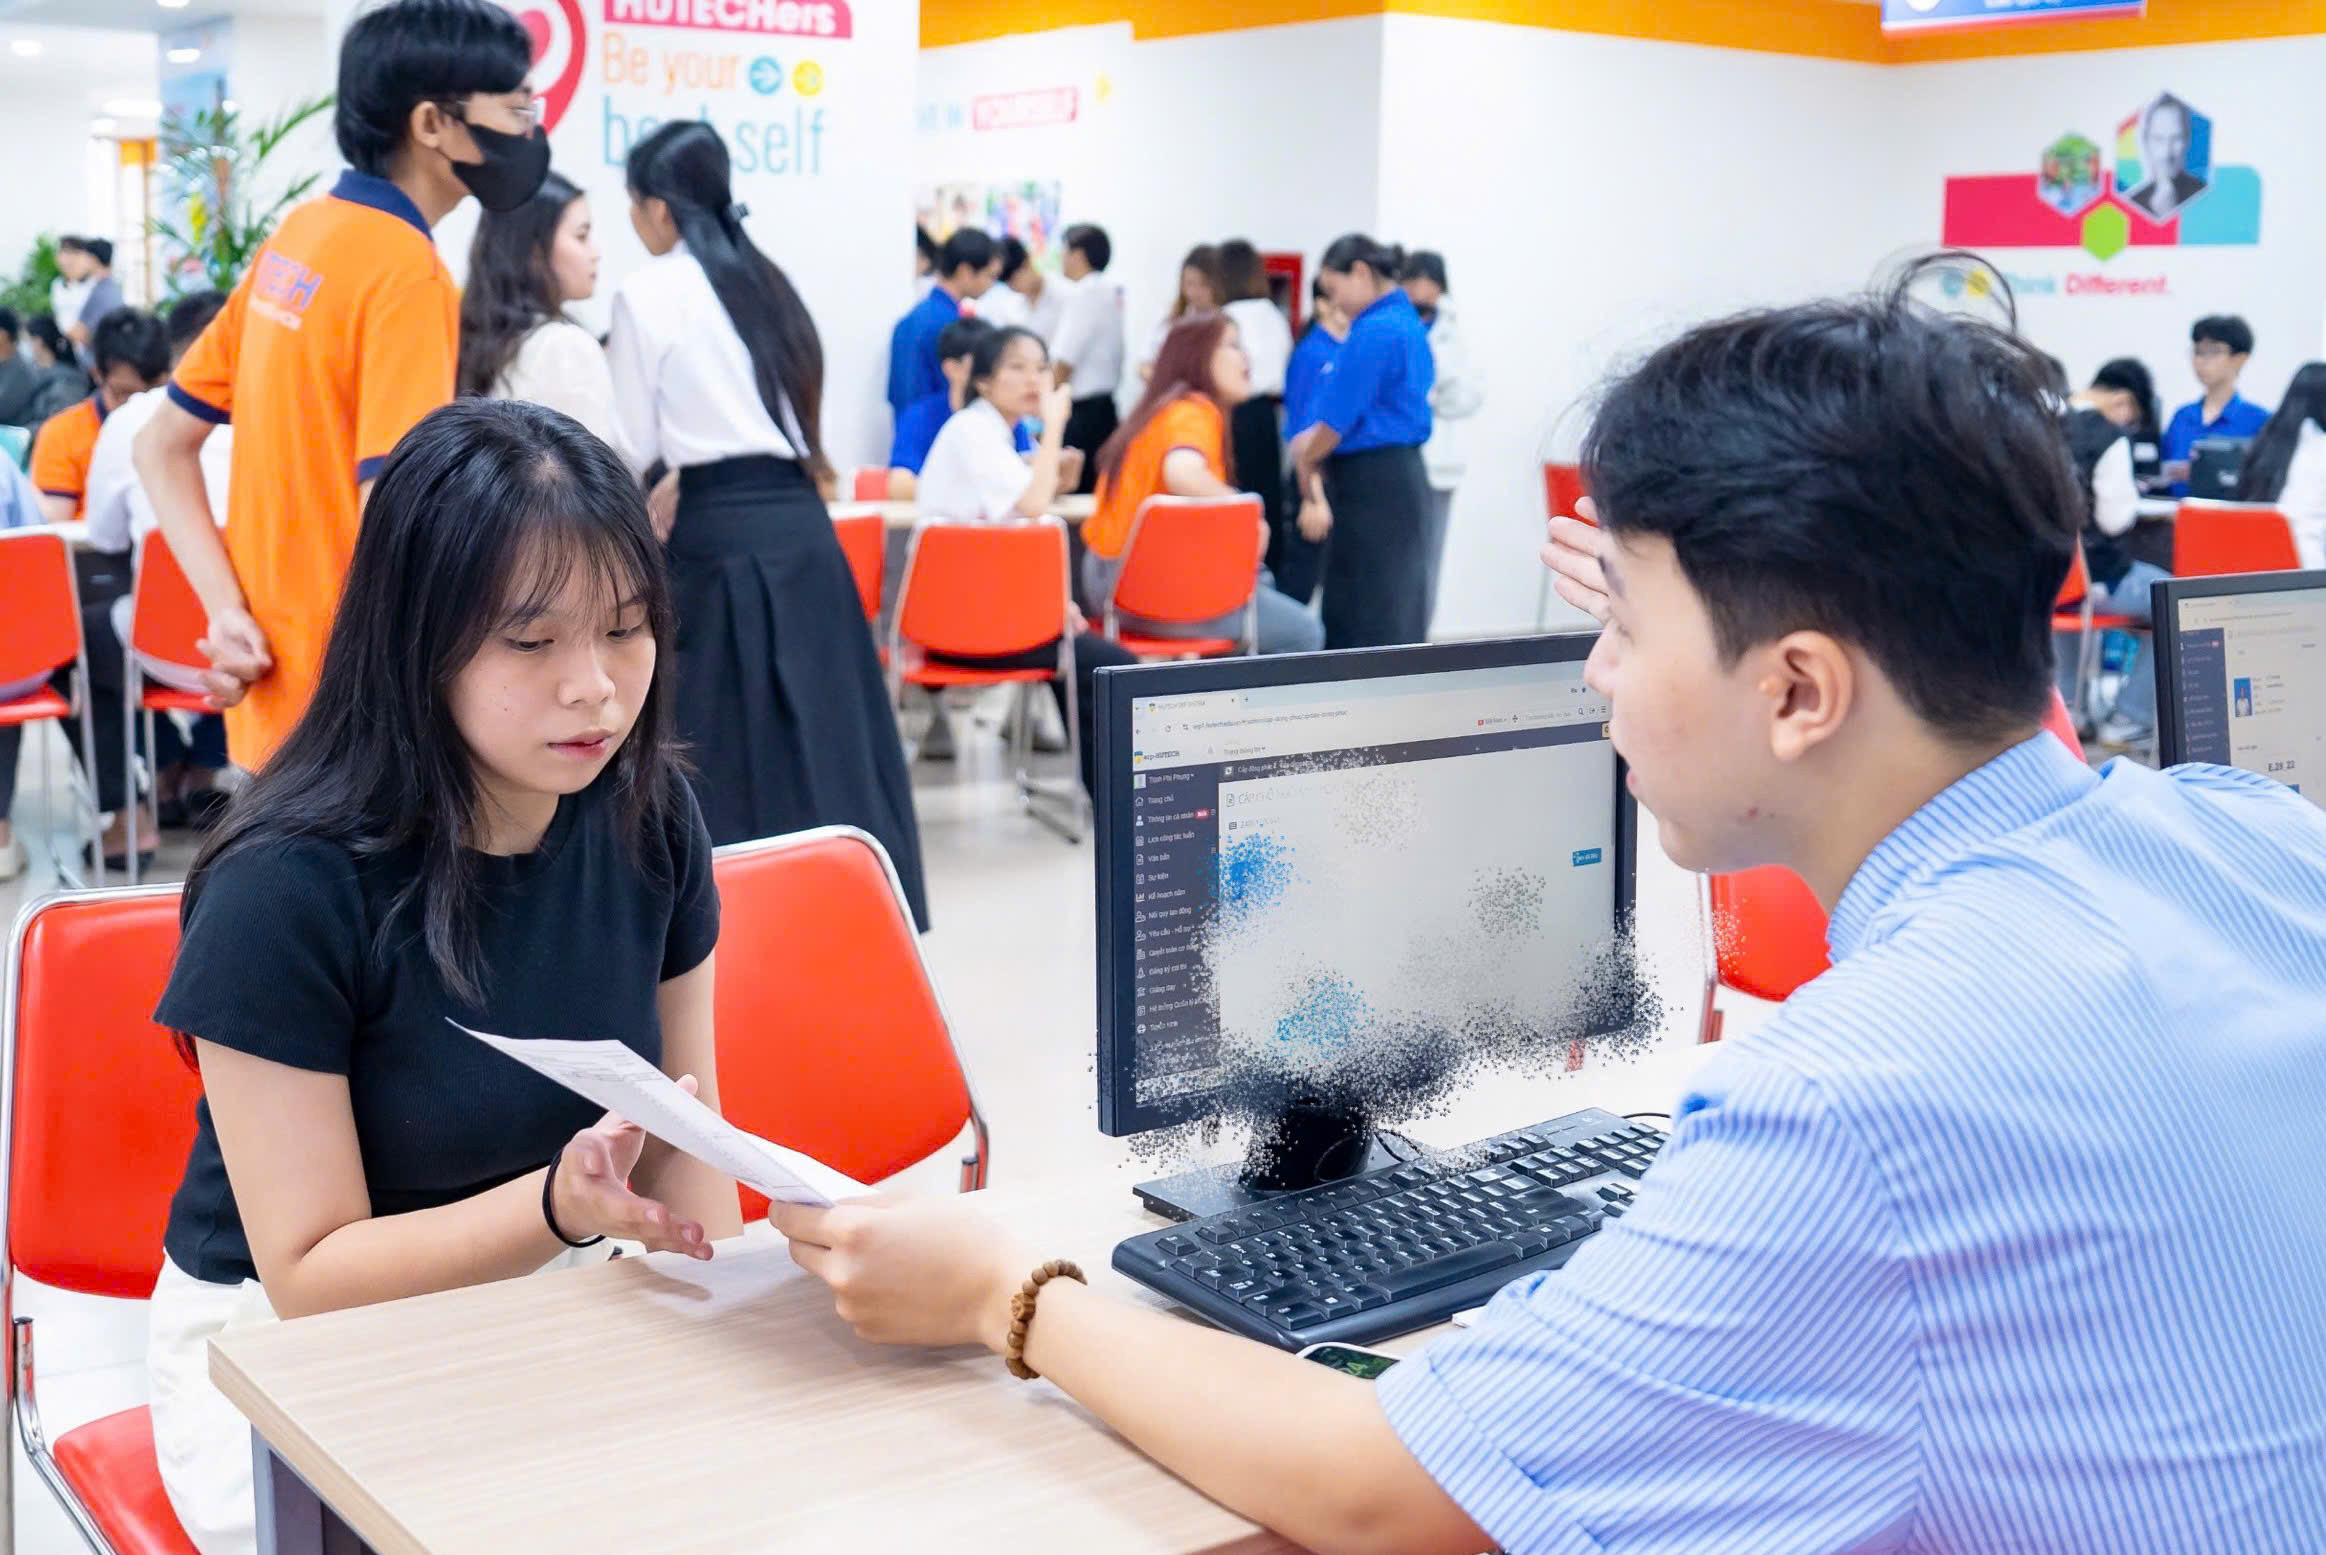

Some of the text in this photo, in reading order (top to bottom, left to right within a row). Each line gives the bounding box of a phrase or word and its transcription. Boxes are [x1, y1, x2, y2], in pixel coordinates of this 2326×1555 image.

[602, 30, 741, 96] Be your
[734, 107, 827, 176] self
